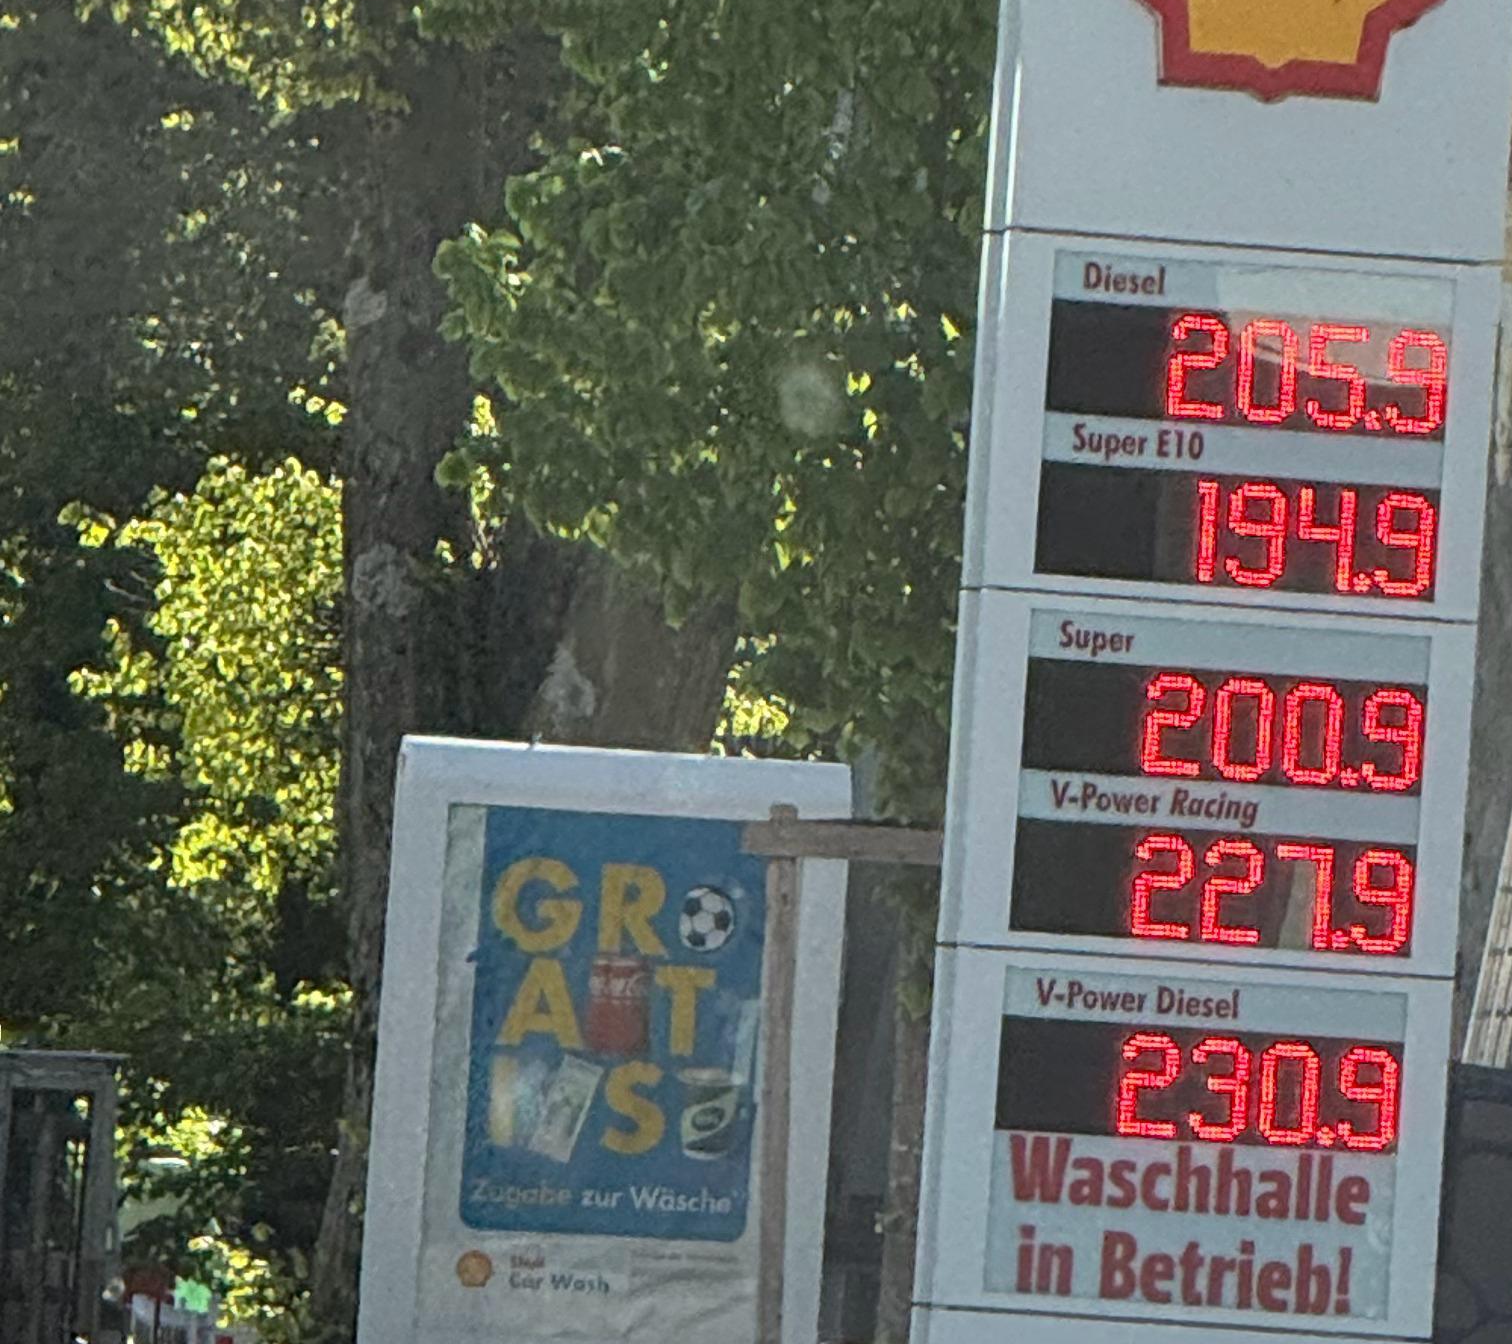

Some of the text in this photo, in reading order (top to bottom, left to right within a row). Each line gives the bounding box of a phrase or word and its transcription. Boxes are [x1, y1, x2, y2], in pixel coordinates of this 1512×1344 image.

[1083, 262, 1166, 297] Diesel
[1165, 312, 1448, 435] 205.9
[1072, 423, 1204, 460] Super E10
[1196, 479, 1438, 597] 194.9
[1059, 619, 1135, 655] Super
[1140, 672, 1424, 792] 200.9
[1052, 779, 1259, 829] V-Power Racing
[1130, 833, 1415, 953] 227.9
[1036, 977, 1239, 1019] V-Power Diesel
[1116, 1031, 1398, 1149] 230.9
[581, 1190, 624, 1208] zur
[1009, 1134, 1370, 1225] Waschhalle
[1015, 1225, 1354, 1316] in Betrieb!
